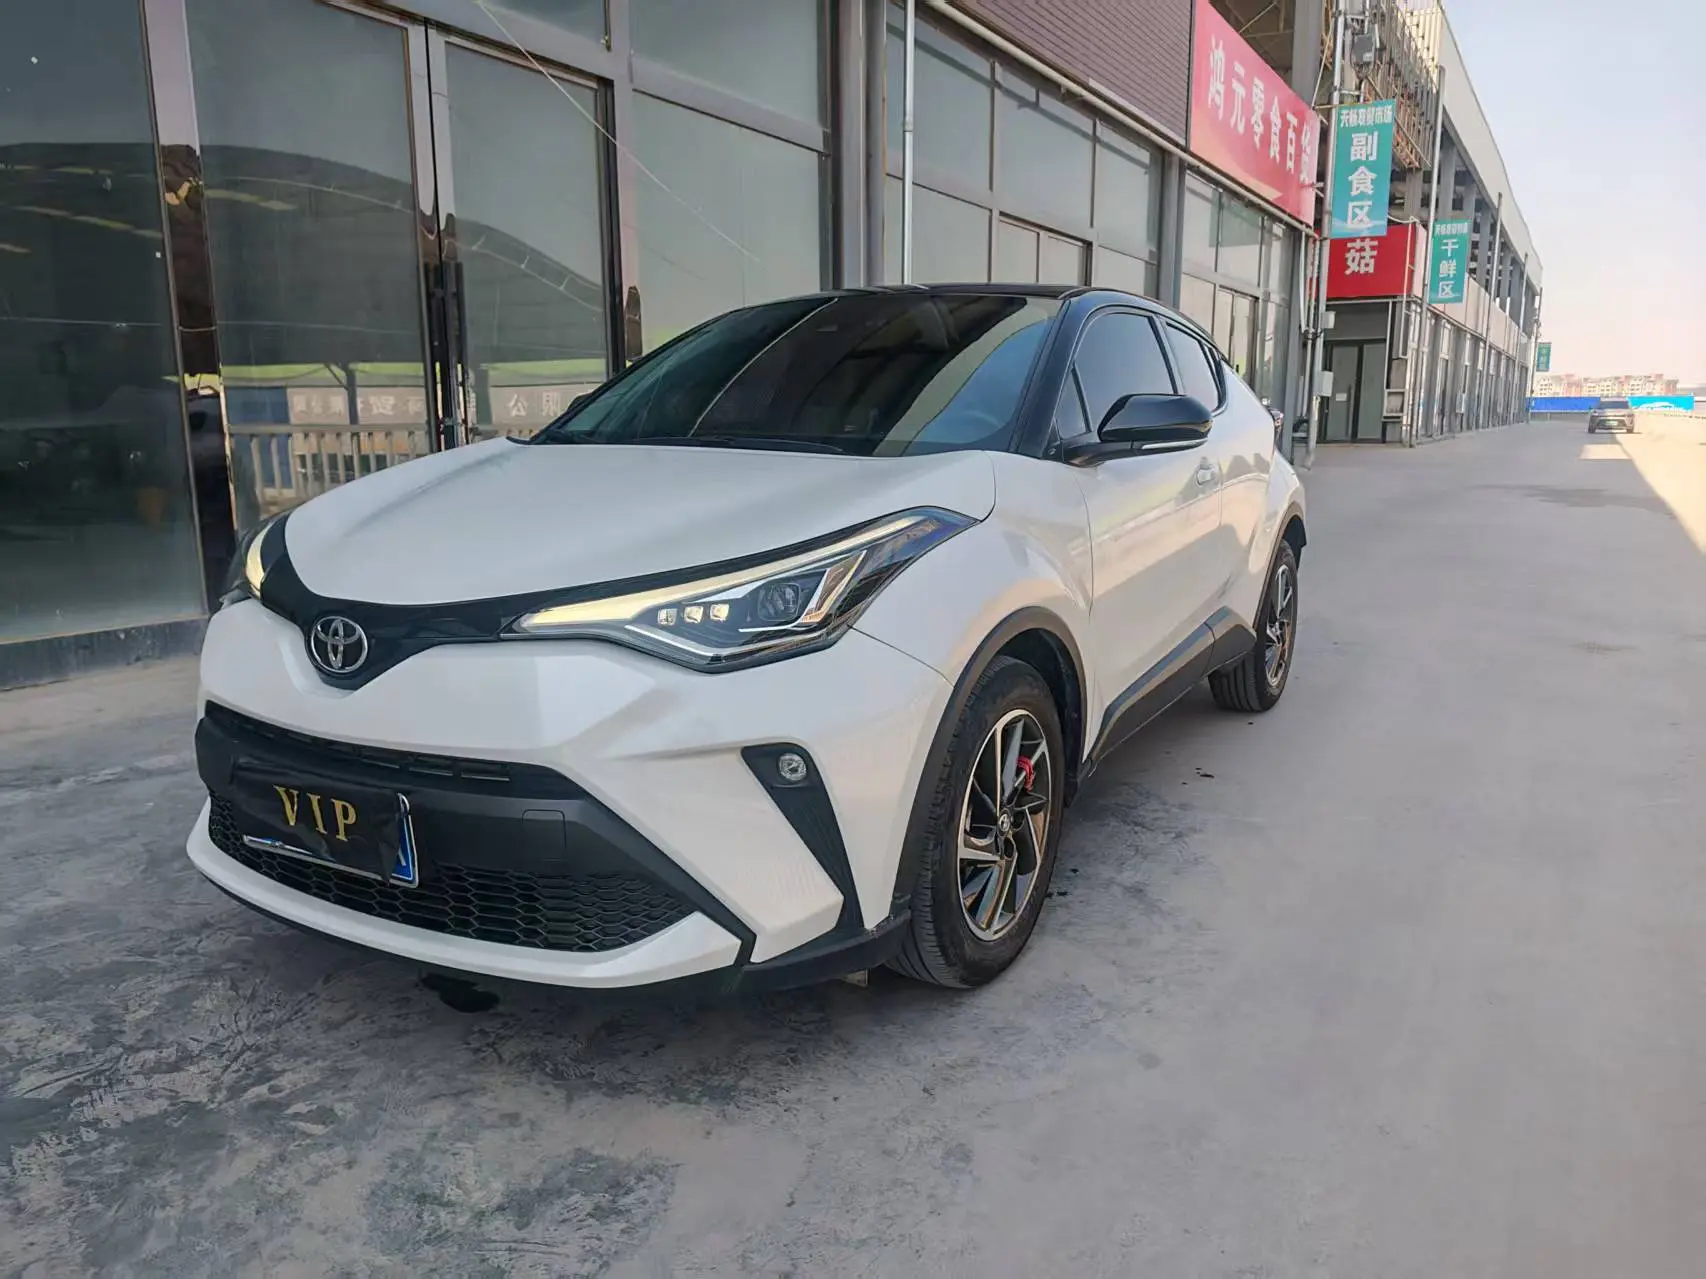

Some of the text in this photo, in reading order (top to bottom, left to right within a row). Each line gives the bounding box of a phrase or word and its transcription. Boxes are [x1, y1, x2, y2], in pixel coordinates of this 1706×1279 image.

[1346, 131, 1378, 229] 副食区
[1344, 238, 1378, 275] 菇
[1437, 238, 1460, 299] 干鲜区
[273, 784, 358, 842] VIP
